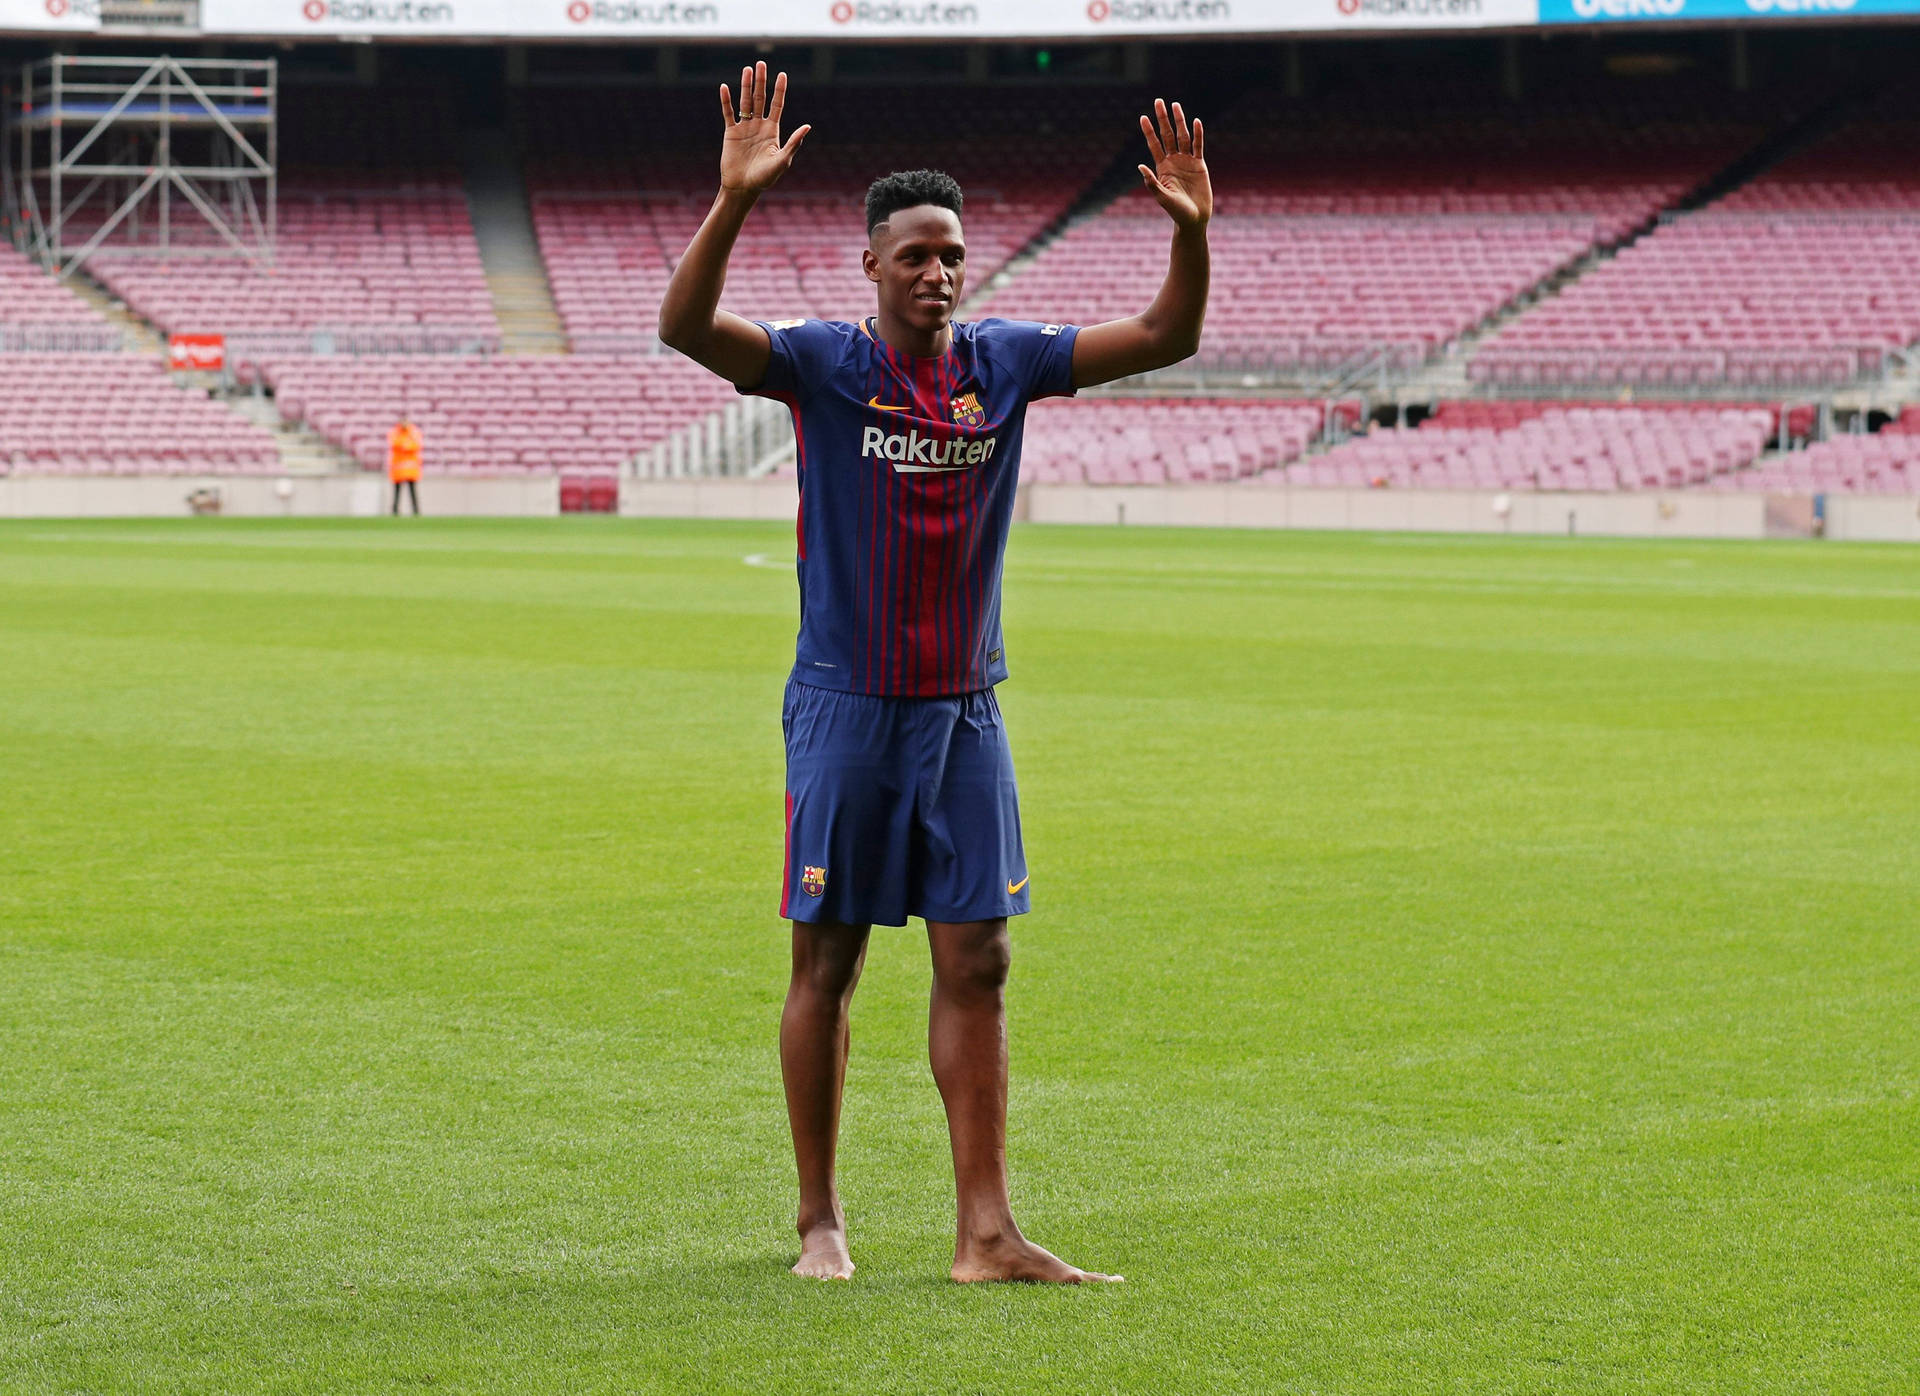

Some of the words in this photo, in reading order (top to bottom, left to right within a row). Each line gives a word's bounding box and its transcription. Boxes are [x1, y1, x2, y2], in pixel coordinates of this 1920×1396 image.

[330, 0, 454, 22] Rakuten
[593, 1, 718, 24] Rakuten
[856, 1, 978, 24] Rakuten
[1111, 0, 1231, 21] Rakuten
[861, 426, 996, 465] Rakuten
